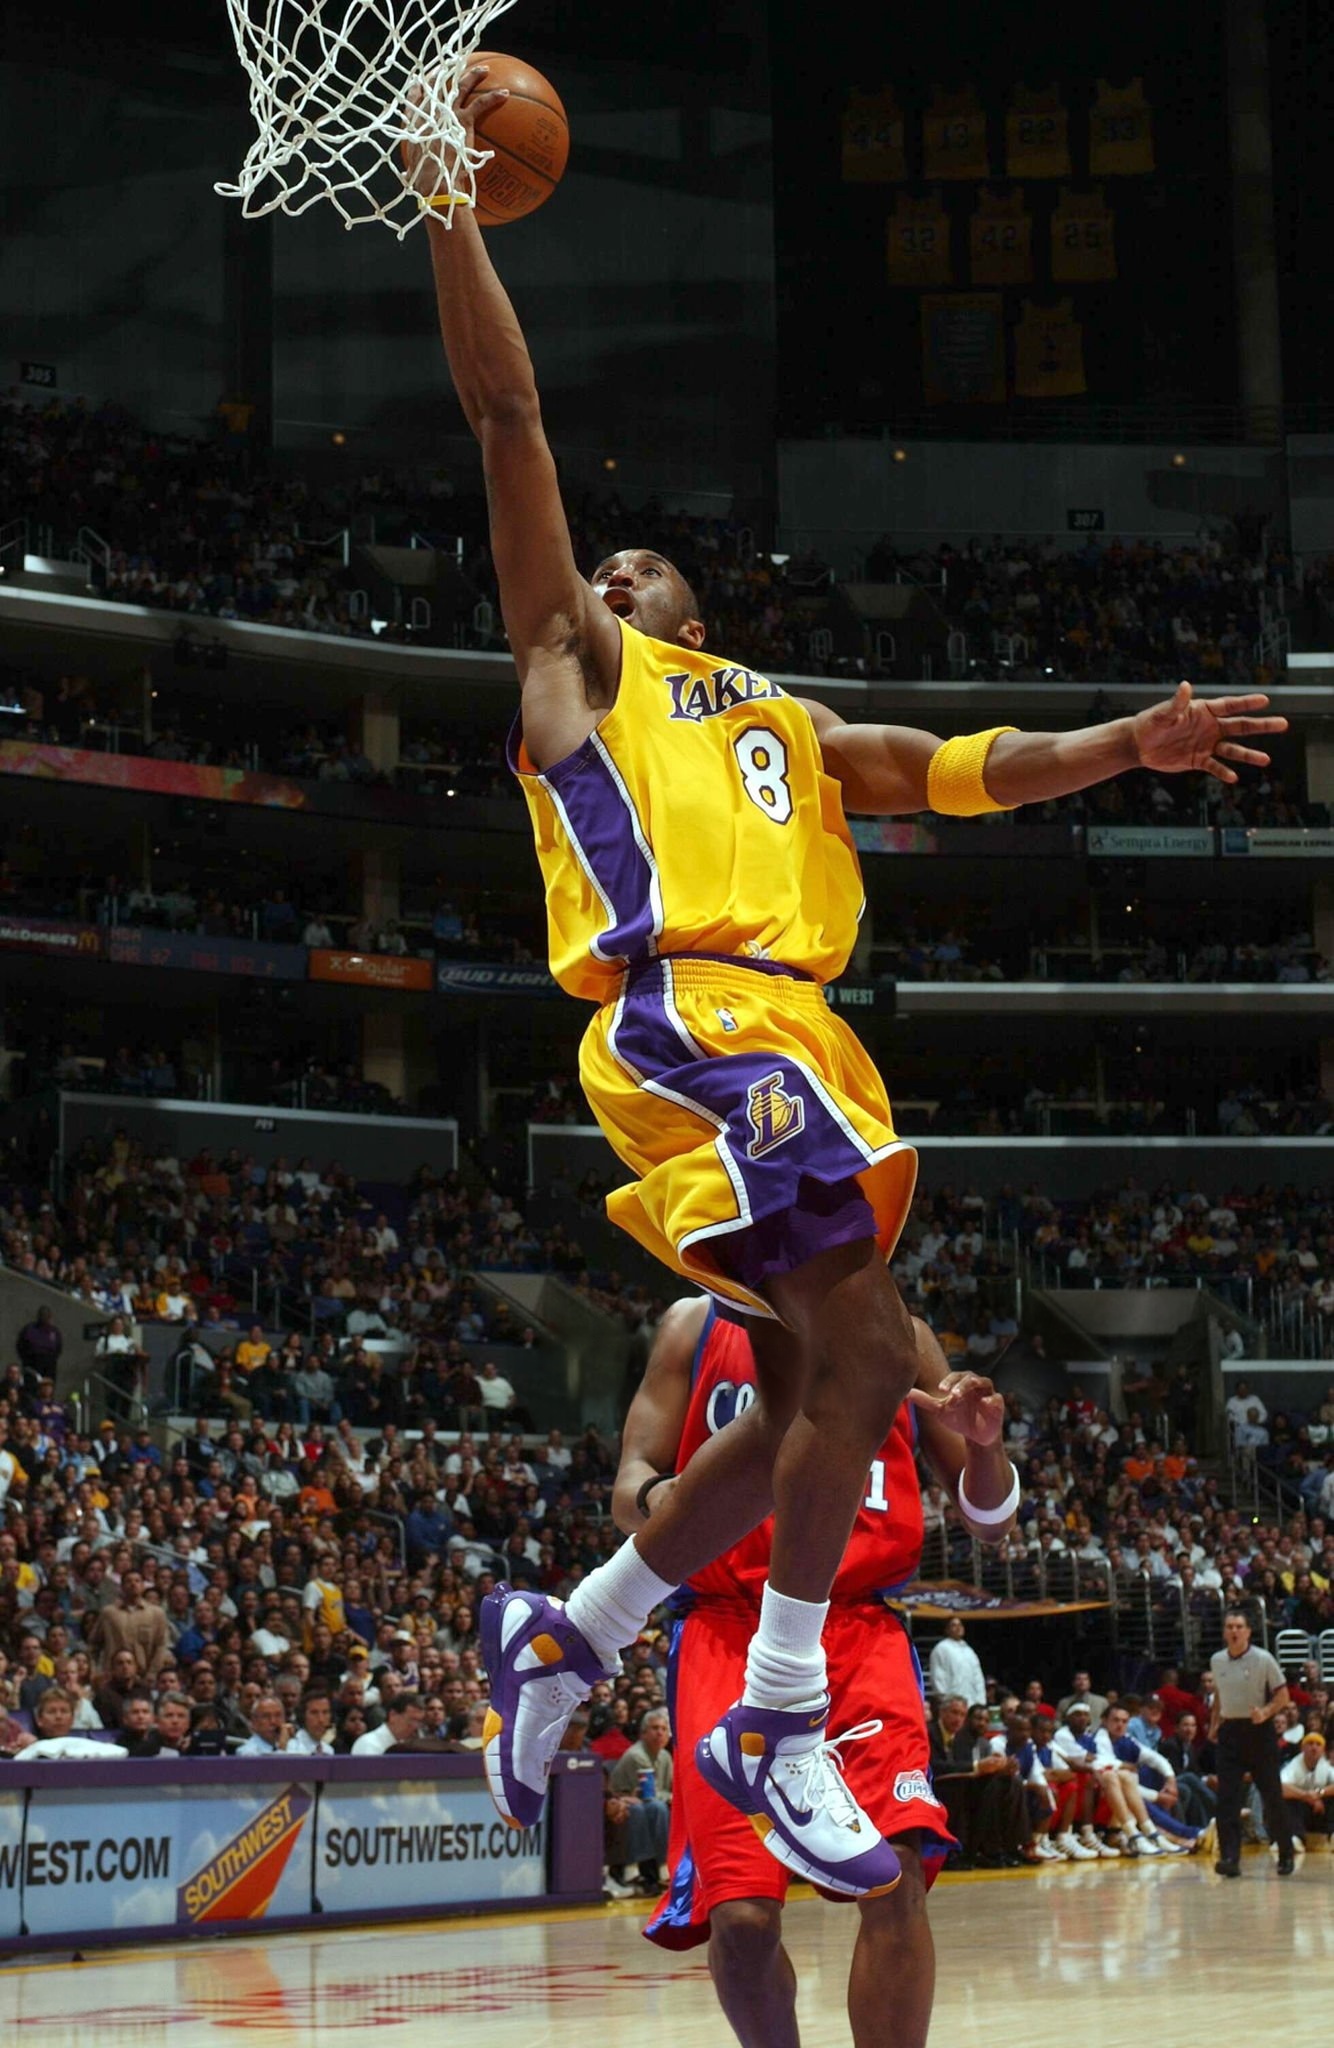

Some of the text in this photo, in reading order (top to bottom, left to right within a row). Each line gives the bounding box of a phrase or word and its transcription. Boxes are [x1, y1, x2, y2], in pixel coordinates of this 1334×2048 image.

[1063, 222, 1102, 251] 25
[1072, 512, 1099, 528] 307
[733, 726, 793, 825] 8
[1111, 834, 1209, 852] Sempra Energy
[446, 969, 495, 983] BUD
[839, 988, 875, 1005] WEST
[184, 1794, 292, 1916] SOUTHWEST
[325, 1822, 542, 1867] SOUTHWEST.COM
